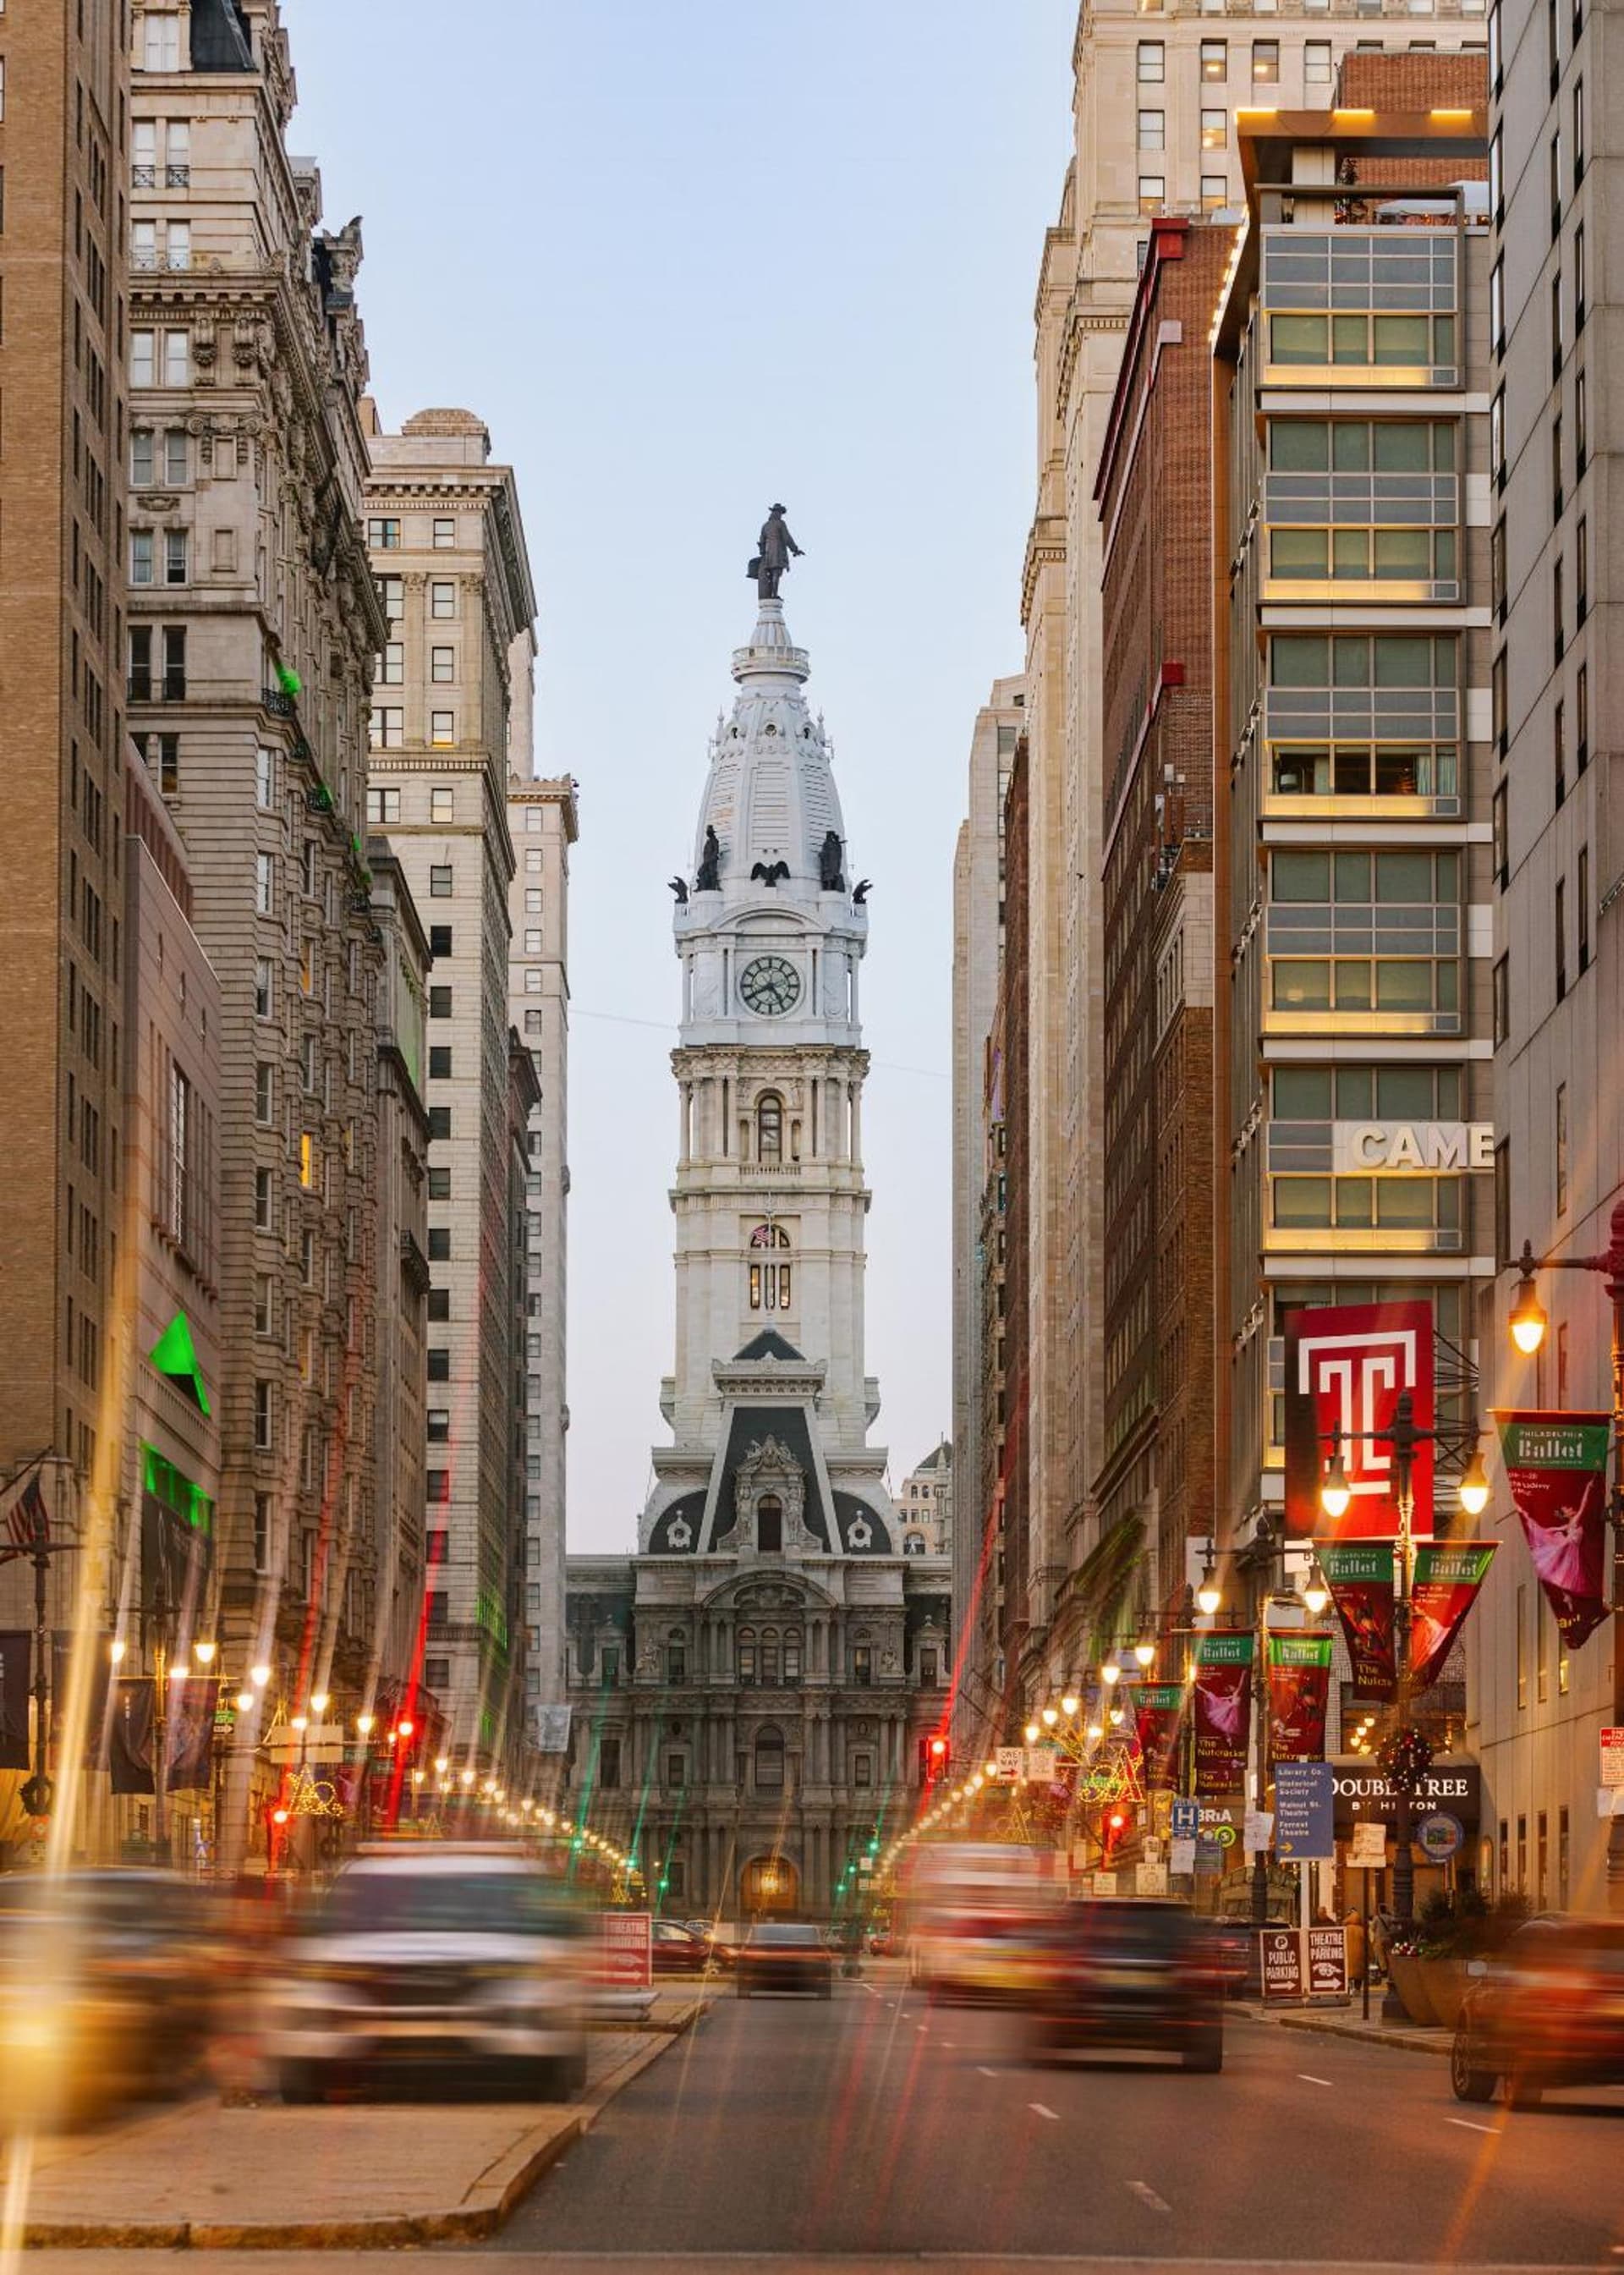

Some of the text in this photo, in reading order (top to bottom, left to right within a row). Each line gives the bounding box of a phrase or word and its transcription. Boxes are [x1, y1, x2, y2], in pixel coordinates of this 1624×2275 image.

[1352, 1126, 1495, 1168] CAME
[1519, 1440, 1583, 1458] Ballet
[1330, 1560, 1377, 1575] Ballet
[1430, 1561, 1478, 1576] Ballet
[1204, 1646, 1240, 1659] Ballet
[1282, 1647, 1320, 1660] Ballet
[1380, 1801, 1437, 1811] HITON
[1177, 1807, 1194, 1825] H
[1310, 1932, 1343, 1946] THEATRE
[1269, 1951, 1296, 1965] PUBLIC
[1310, 1947, 1344, 1959] PARKING
[1265, 1965, 1299, 1979] PARKING
